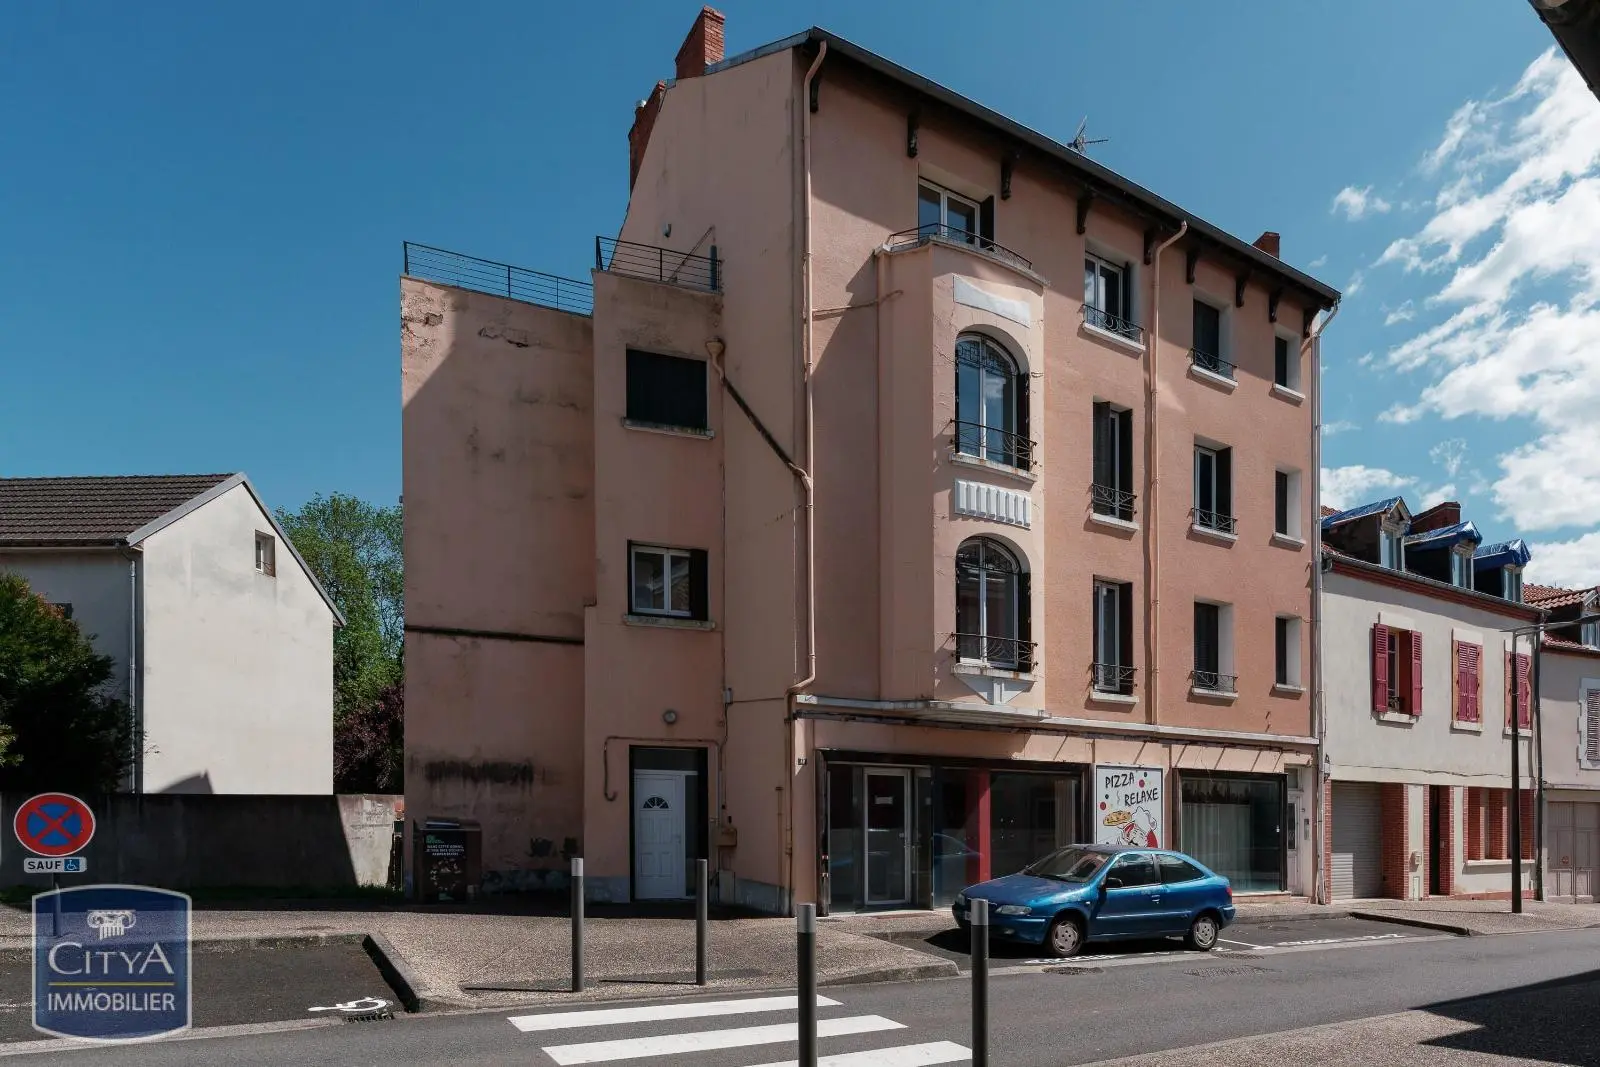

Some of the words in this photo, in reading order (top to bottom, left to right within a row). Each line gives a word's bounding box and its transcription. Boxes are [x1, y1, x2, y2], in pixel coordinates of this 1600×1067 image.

[1105, 772, 1135, 788] PIZZA
[1124, 788, 1159, 806] RELAXE
[27, 860, 61, 870] SAUF
